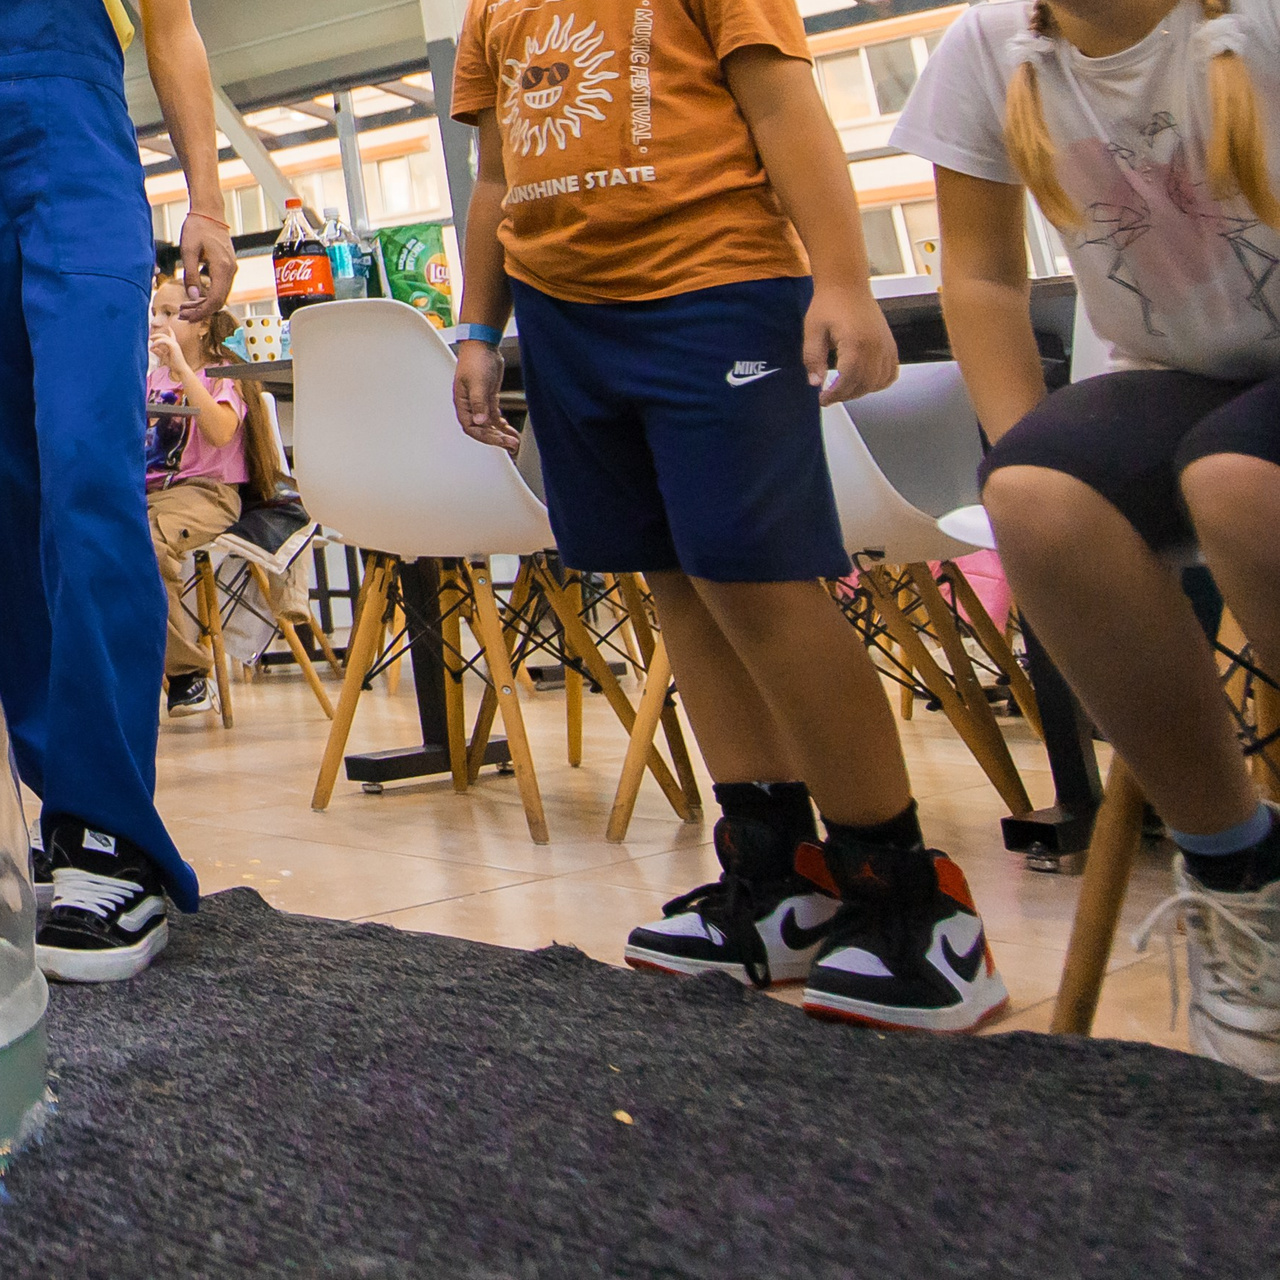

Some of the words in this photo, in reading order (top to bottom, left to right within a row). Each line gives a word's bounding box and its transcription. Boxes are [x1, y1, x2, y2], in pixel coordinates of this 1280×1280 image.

[630, 8, 654, 64] MUSIC
[630, 65, 652, 146] FESTIVAL
[584, 165, 656, 190] STATE
[733, 360, 768, 375] NIKE
